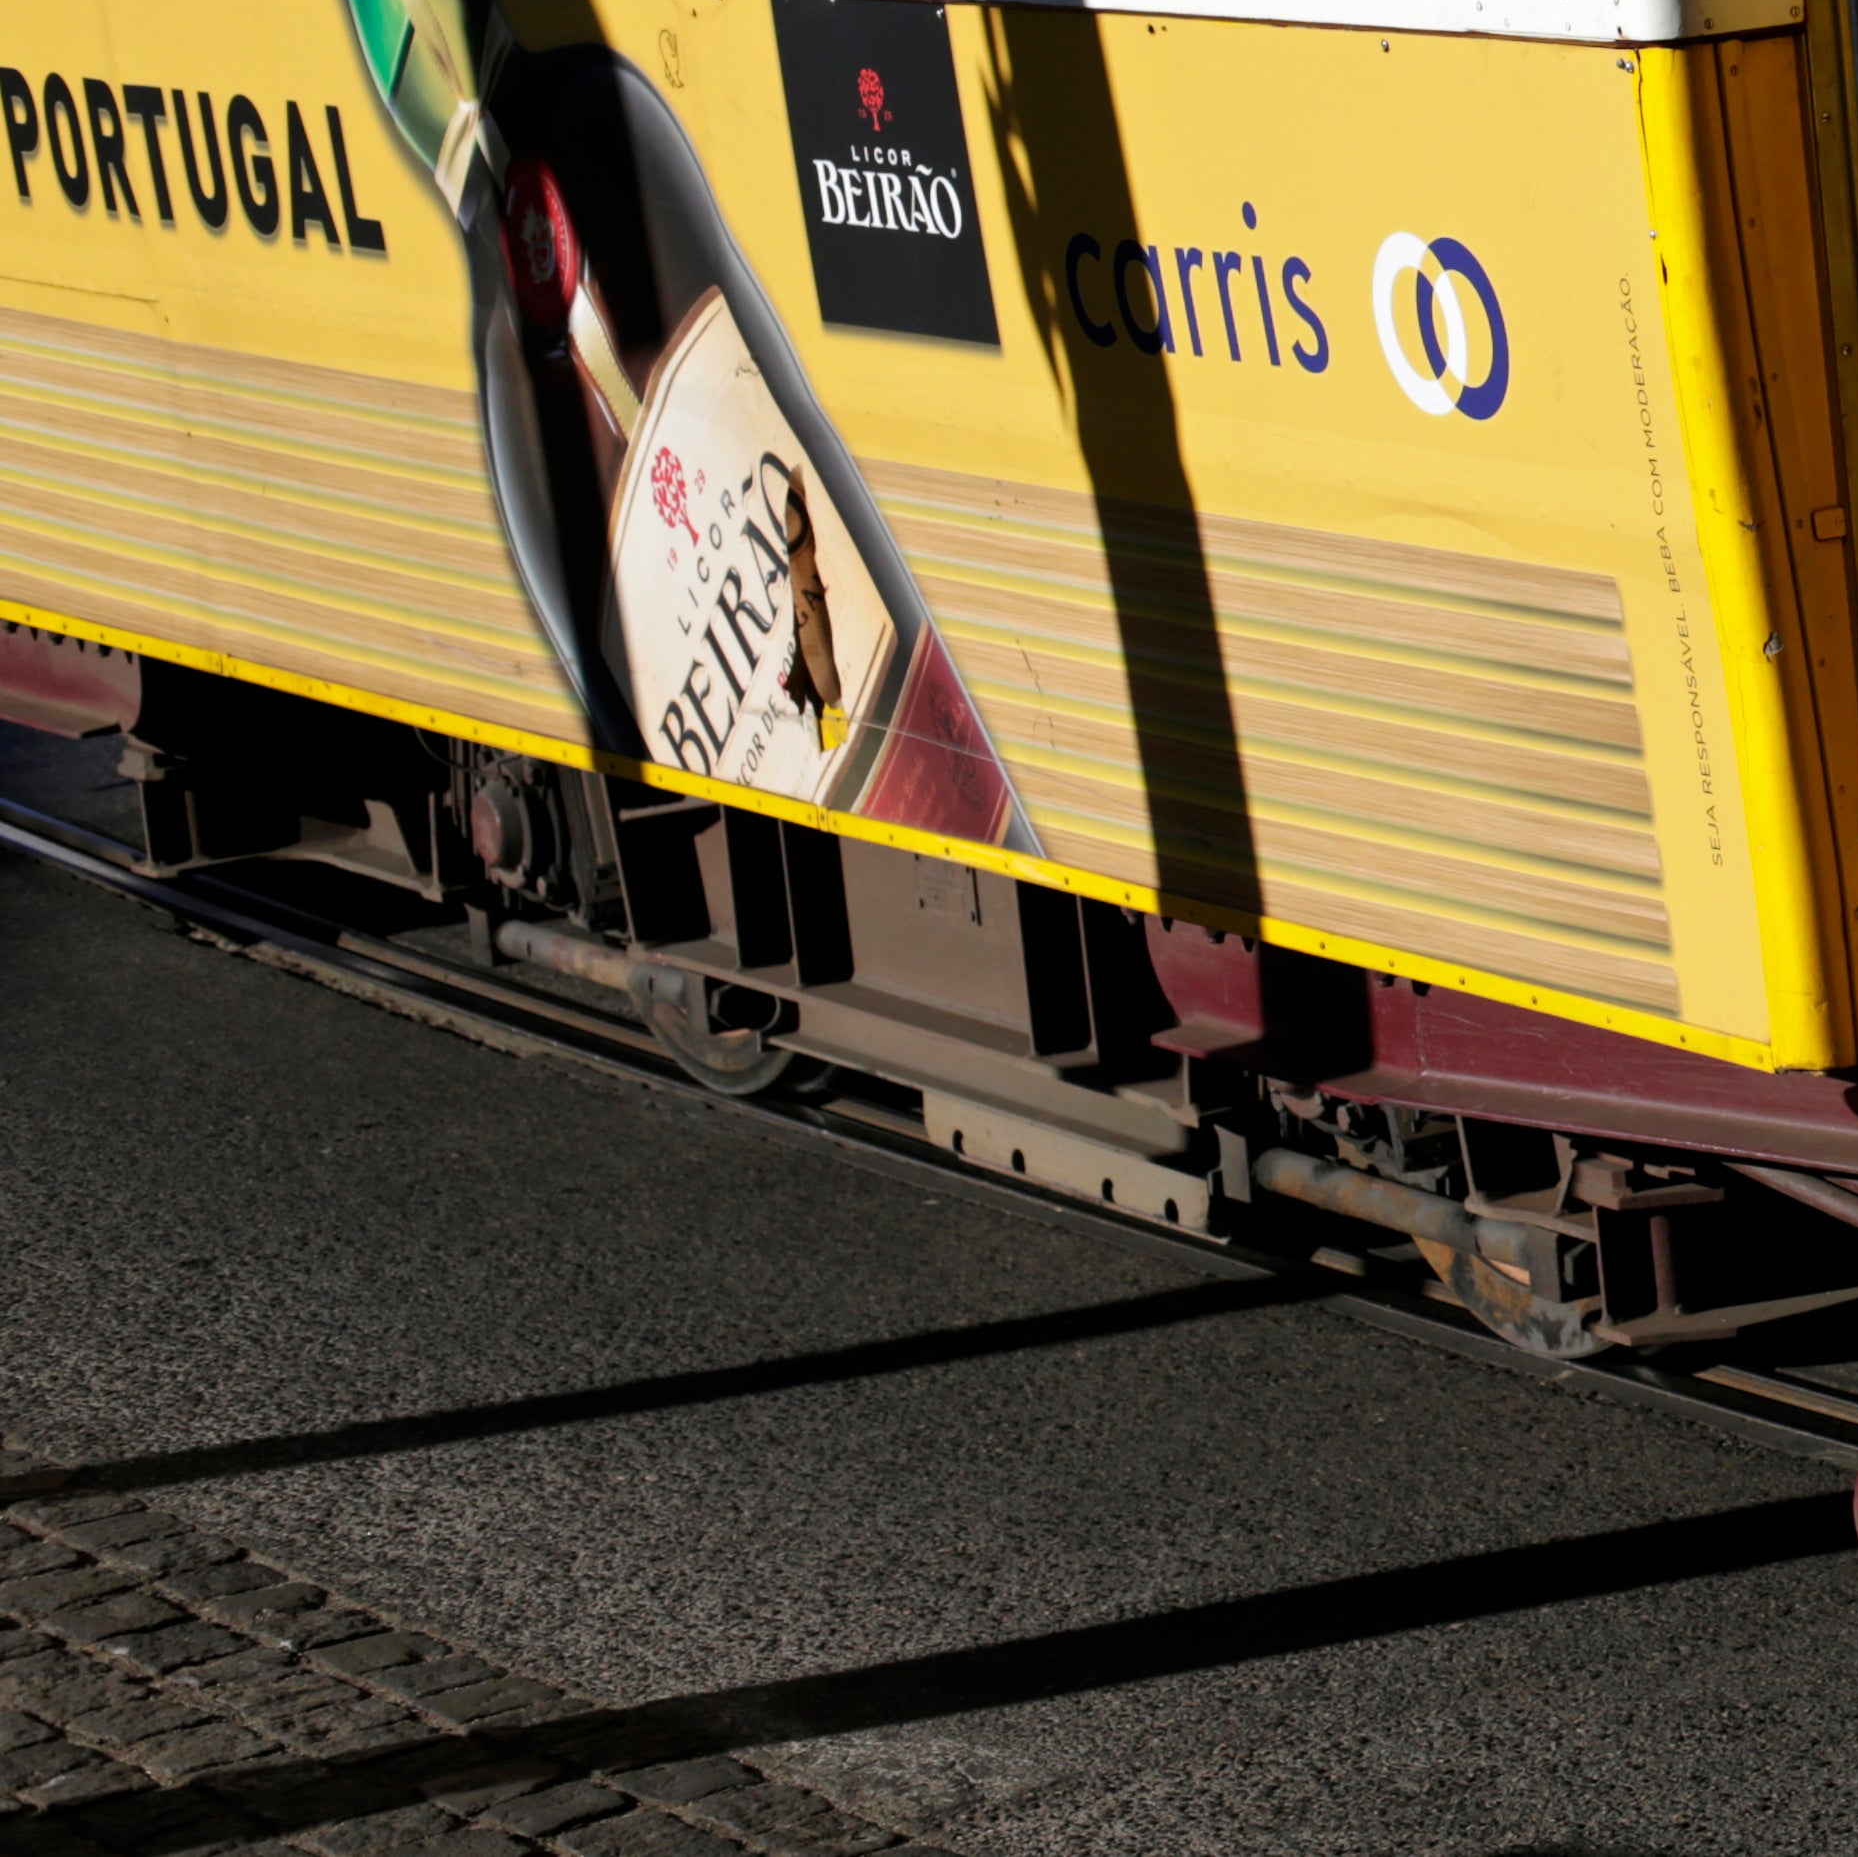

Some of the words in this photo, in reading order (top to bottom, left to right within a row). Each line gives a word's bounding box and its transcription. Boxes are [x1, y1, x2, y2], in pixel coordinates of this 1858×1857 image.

[0, 66, 388, 254] PORTUGAL
[812, 158, 963, 239] BEIRÃO
[850, 144, 912, 167] LICOR
[1066, 201, 1330, 374] carris
[1618, 271, 1656, 449] MODERAÇÃO.
[1649, 458, 1665, 517] COM
[657, 450, 812, 782] BEIRÃO
[676, 488, 737, 638] LICOR
[1655, 525, 1681, 593] BEBA
[761, 693, 781, 735] DE
[1675, 602, 1714, 795] RESPONSÁVEL.
[1704, 804, 1723, 868] SEJA
